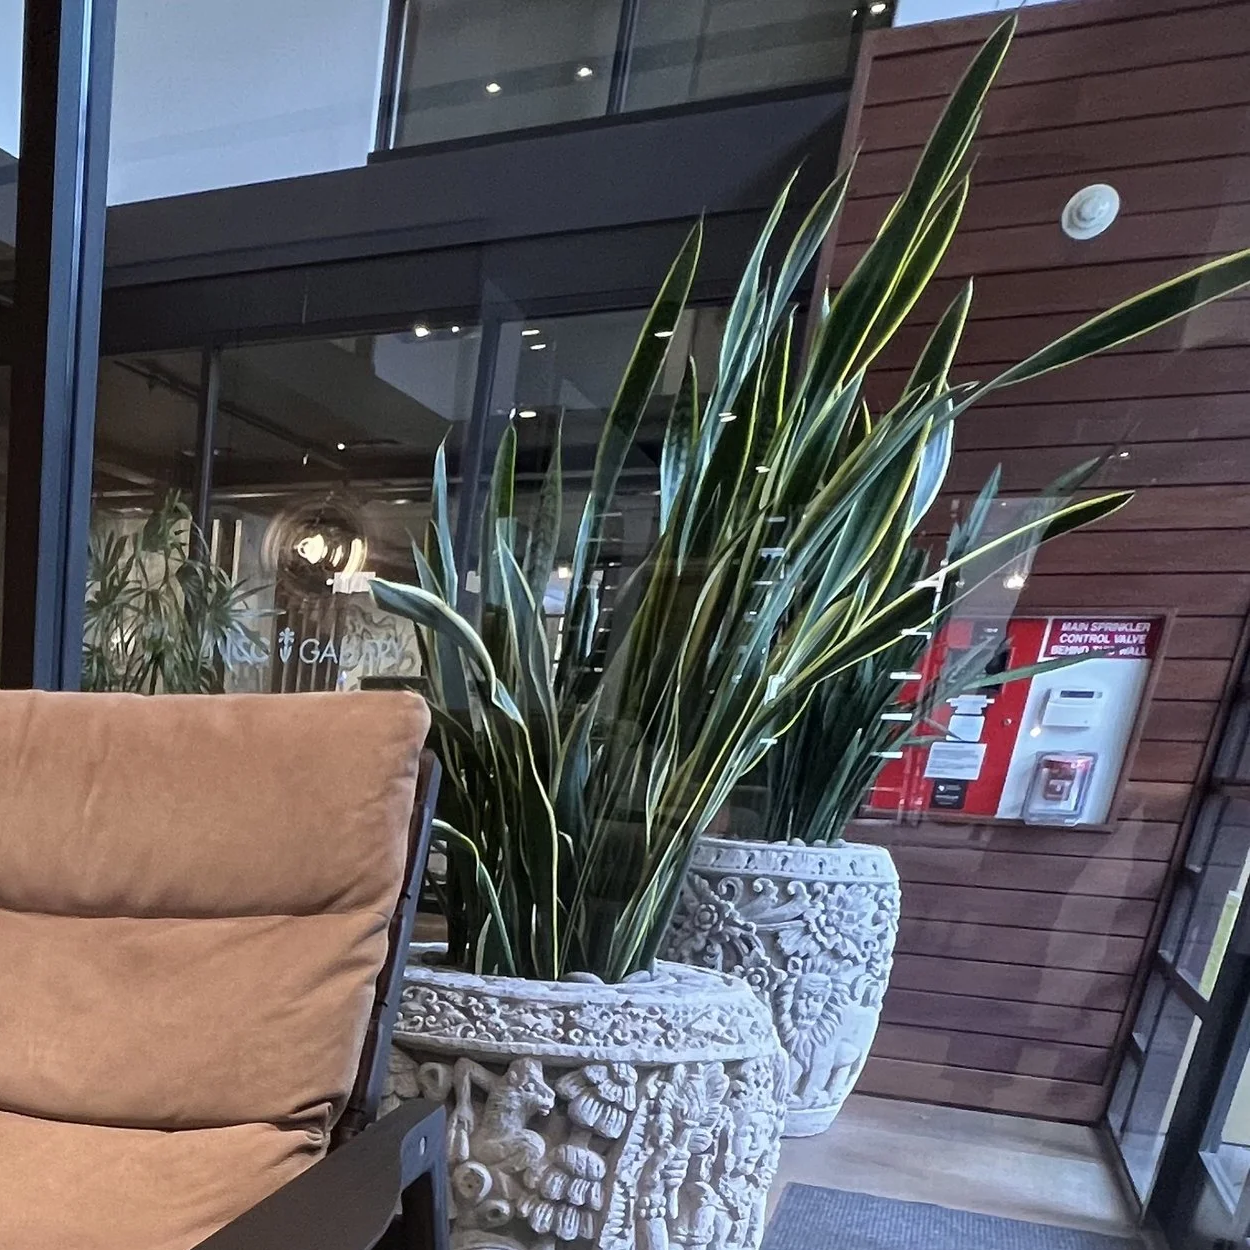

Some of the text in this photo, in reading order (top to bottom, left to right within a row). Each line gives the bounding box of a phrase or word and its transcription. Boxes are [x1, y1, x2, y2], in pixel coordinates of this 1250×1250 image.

[1061, 622, 1151, 632] MAIN SPRINKLER
[1059, 633, 1147, 645] CONTROL VALVE
[1050, 645, 1090, 656] BEHIND
